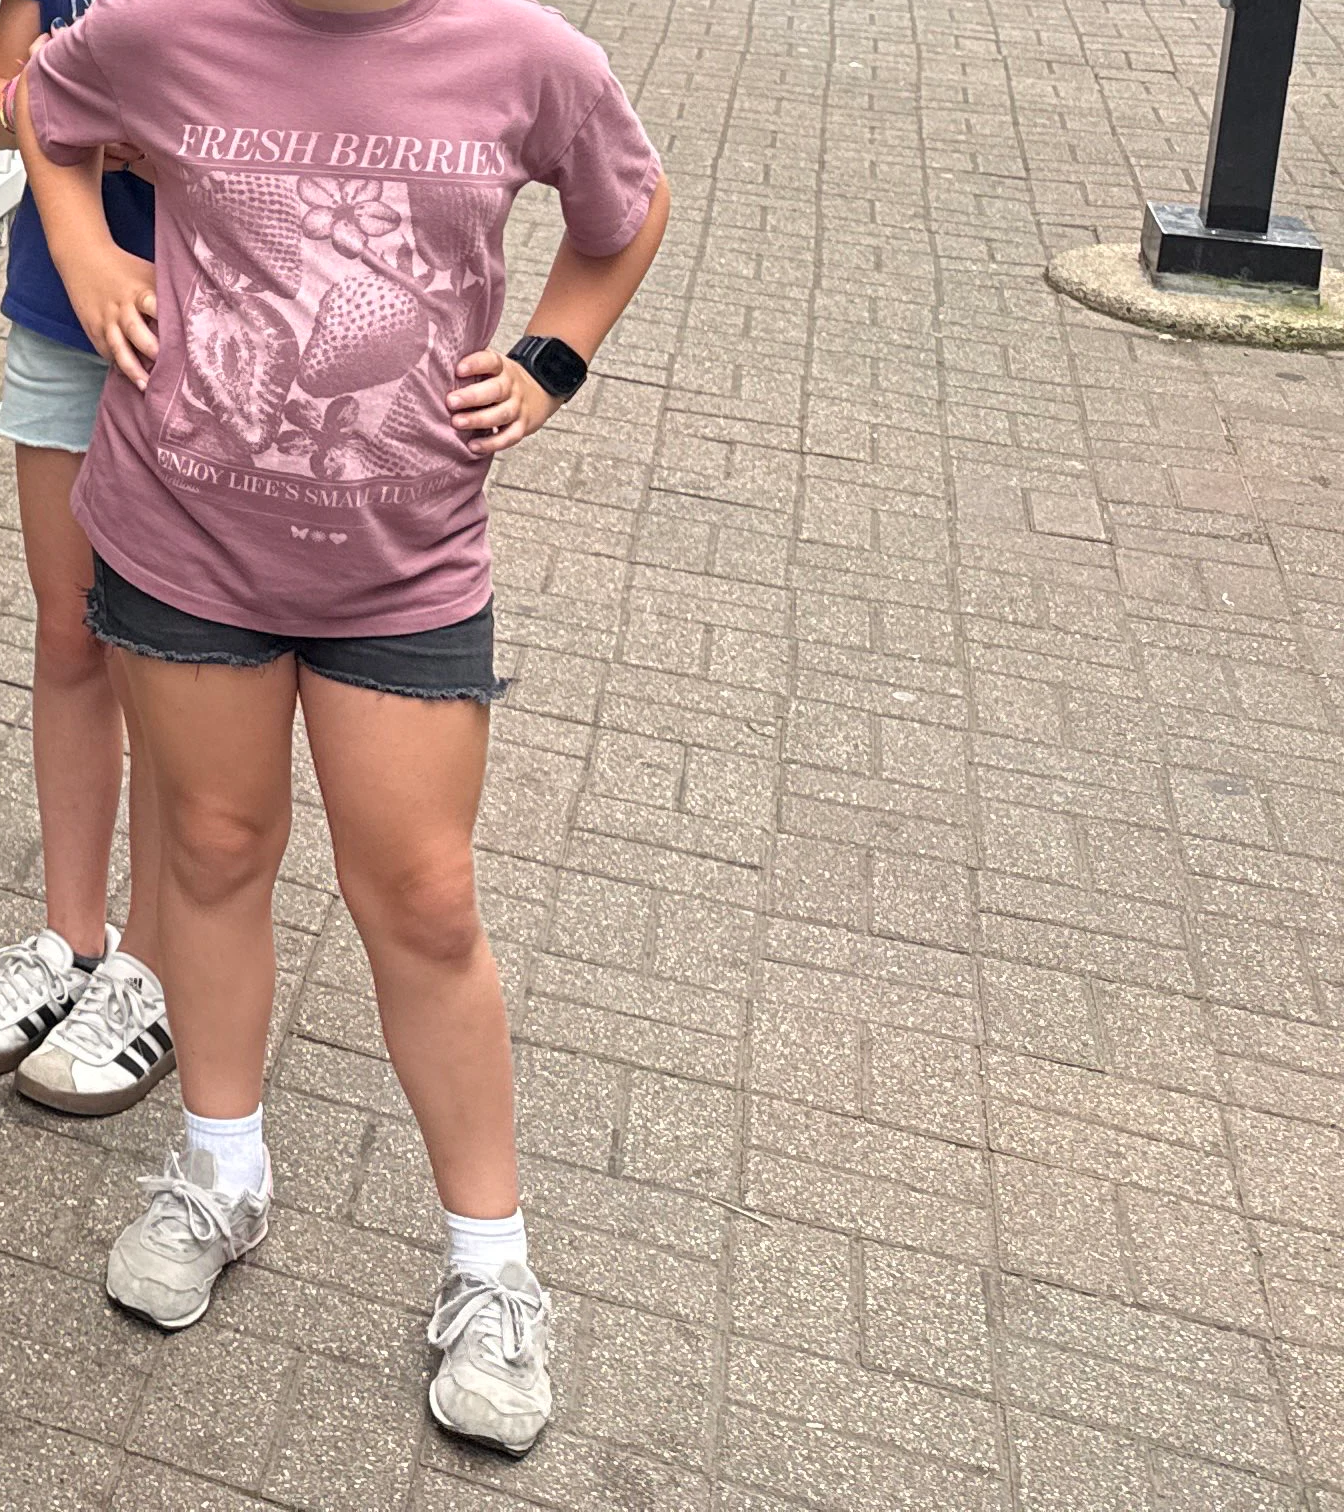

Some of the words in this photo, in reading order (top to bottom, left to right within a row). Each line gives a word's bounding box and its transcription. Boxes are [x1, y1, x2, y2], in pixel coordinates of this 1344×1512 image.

[175, 124, 321, 165] FRESH
[328, 133, 506, 176] BERRIES
[156, 447, 225, 485] ENJOY
[303, 487, 374, 509] SMALL
